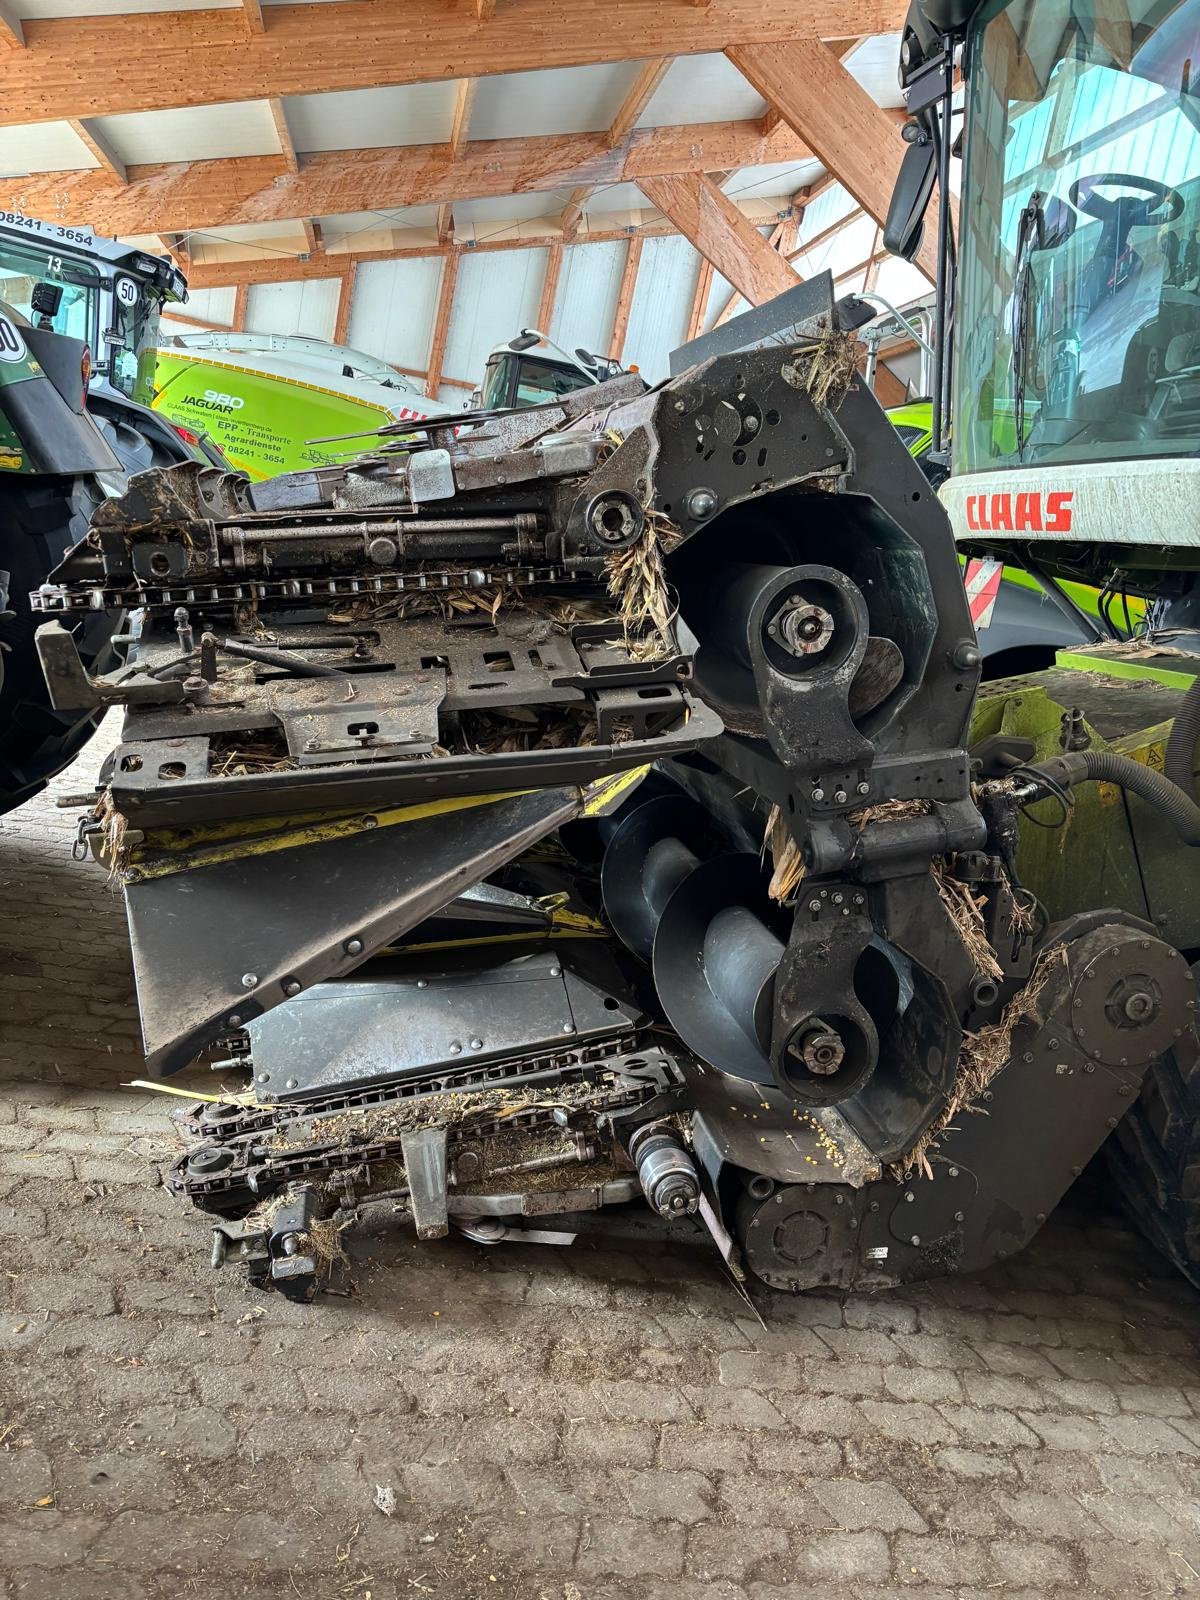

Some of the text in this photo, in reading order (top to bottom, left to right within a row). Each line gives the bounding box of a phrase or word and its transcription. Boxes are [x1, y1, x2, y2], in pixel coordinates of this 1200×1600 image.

[0, 211, 42, 230] 08241
[56, 227, 93, 246] 3654
[47, 255, 62, 272] 13
[121, 282, 134, 301] 50
[0, 318, 19, 352] 0
[181, 395, 234, 415] JAGUAR
[203, 389, 244, 409] 980
[217, 420, 238, 431] EPP
[247, 427, 292, 445] Transporte
[224, 433, 282, 452] Agrardienste
[228, 445, 255, 457] 08241
[263, 453, 285, 464] 3654
[966, 492, 1074, 531] CLAAS
